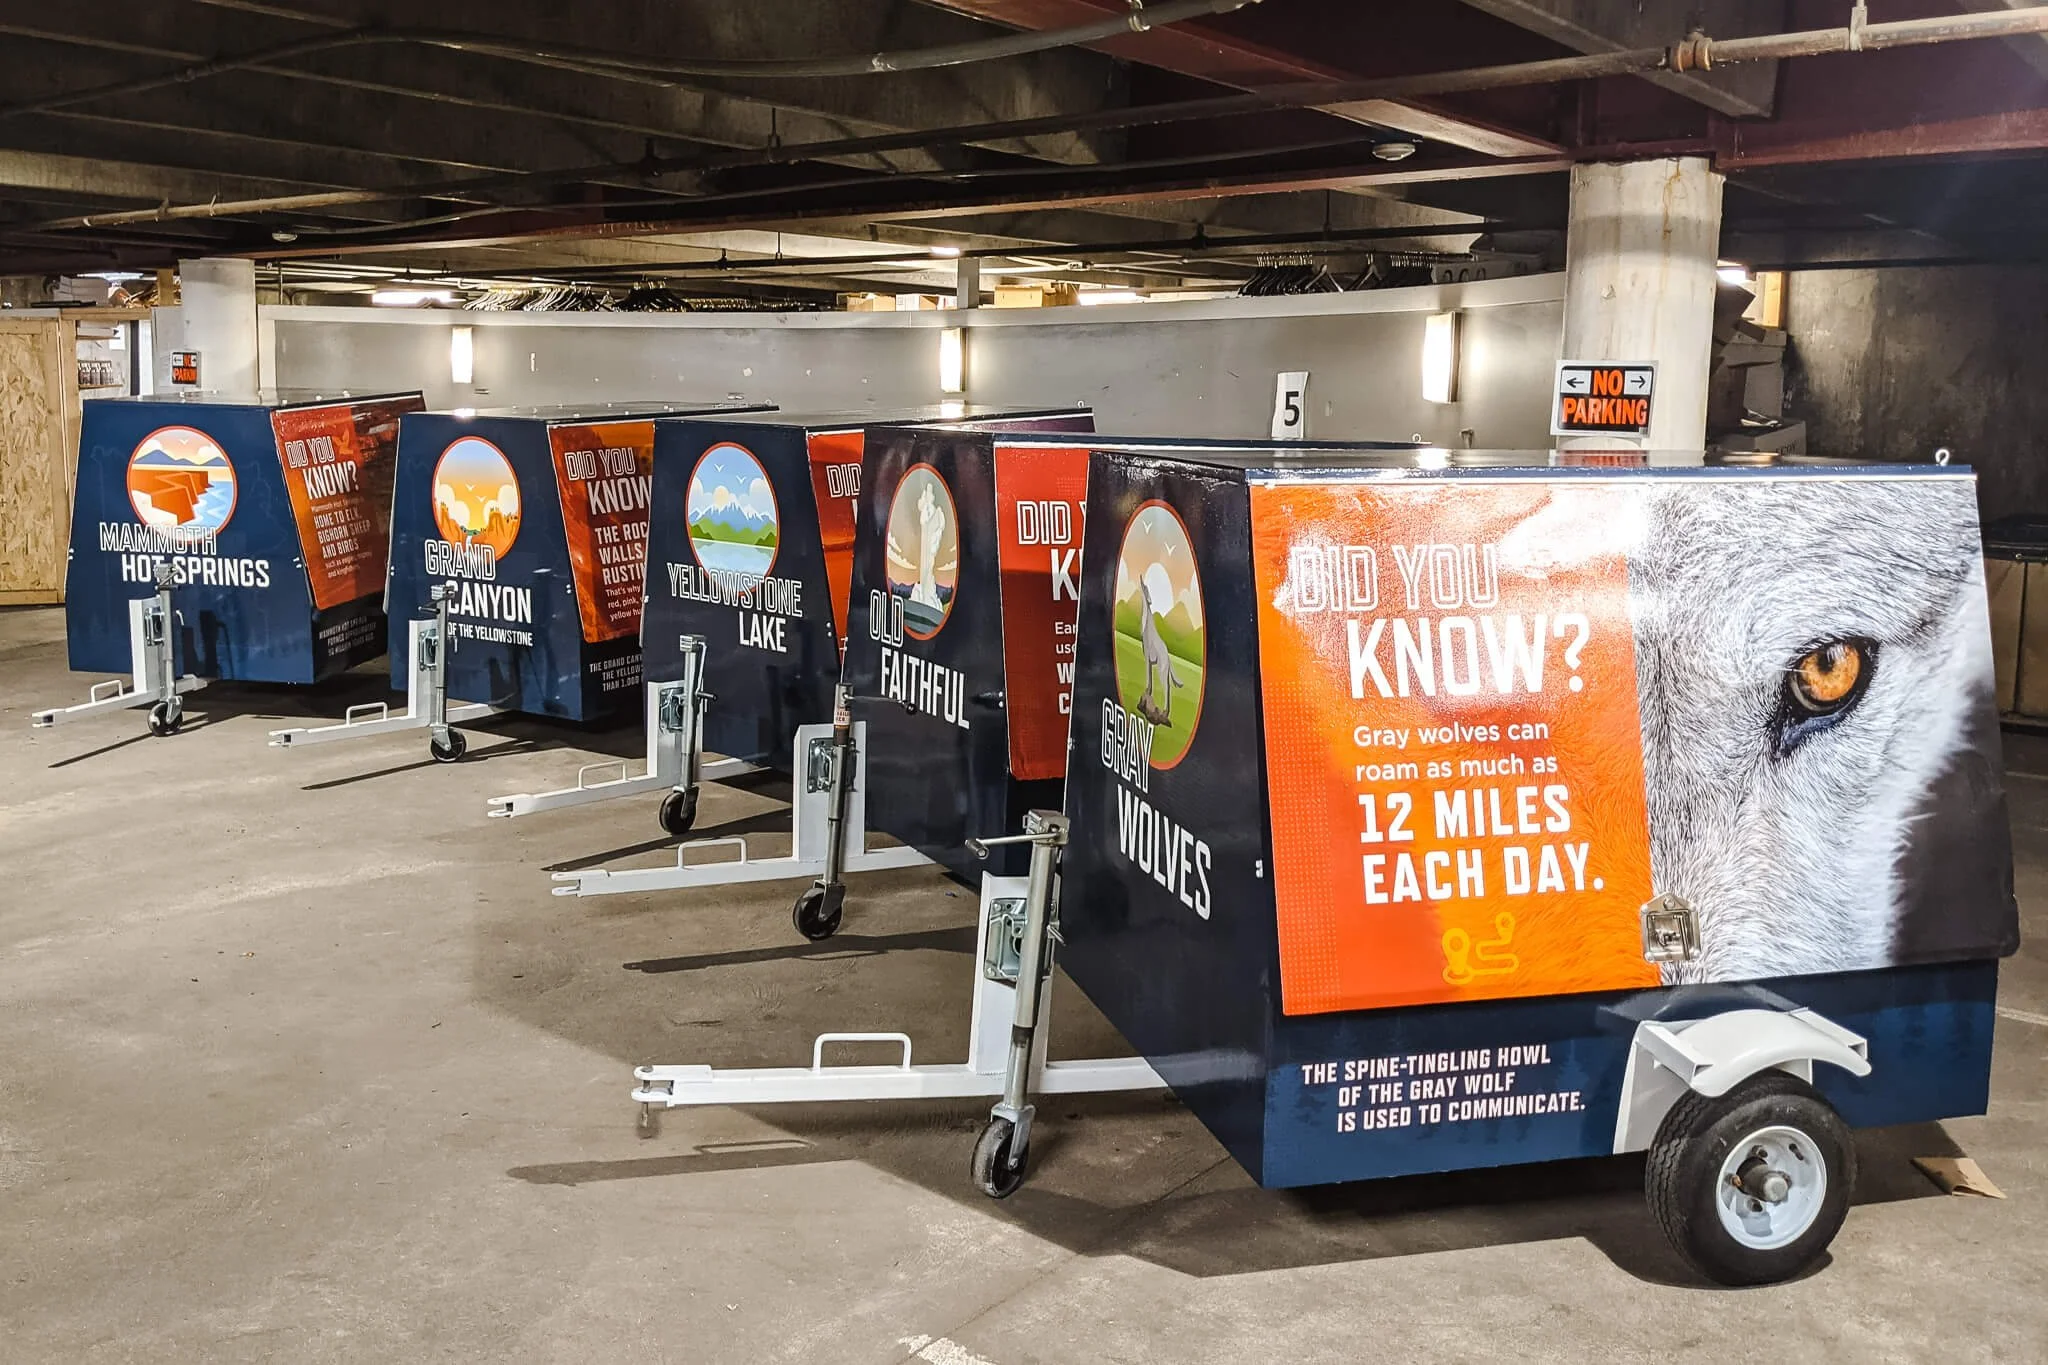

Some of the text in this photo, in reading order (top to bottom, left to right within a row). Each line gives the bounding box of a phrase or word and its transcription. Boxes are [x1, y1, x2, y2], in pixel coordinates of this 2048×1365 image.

[1593, 369, 1623, 396] NO
[1284, 391, 1300, 426] 5
[1562, 398, 1648, 425] PARKING
[285, 436, 335, 468] DID YOU
[564, 447, 636, 480] DID YOU
[302, 461, 360, 500] KNOW?
[826, 463, 862, 498] DID
[314, 512, 334, 529] HOME
[334, 510, 345, 524] TO
[317, 520, 371, 544] BIGHORN SHEEP
[594, 526, 620, 544] THE
[1016, 500, 1072, 545] DID
[99, 522, 217, 556] MAMMOTH
[322, 543, 336, 560] AND
[337, 538, 359, 554] BIRDS
[598, 542, 644, 565] WALLS
[172, 556, 270, 588] SPRINGS
[424, 539, 496, 580] GRAND
[605, 585, 640, 597] That's why
[666, 562, 803, 617] YELLOWSTONE
[1290, 543, 1499, 613] DID YOU
[445, 580, 532, 624] CANYON
[608, 600, 622, 609] red,
[610, 609, 632, 622] yellow
[870, 588, 904, 648] OLD
[447, 622, 533, 647] OF THE YELLOWSTONE
[738, 611, 787, 653] LAKE
[589, 662, 602, 672] THE
[604, 656, 625, 670] GRAND
[602, 664, 644, 681] THE YELLOW
[1347, 613, 1590, 699] KNOW?
[602, 680, 620, 692] THAN
[880, 646, 970, 730] FAITHFUL
[1102, 698, 1154, 794] GRAY
[1353, 722, 1549, 748] Gray wolves can
[1356, 753, 1558, 781] roam as much as
[1358, 784, 1571, 844] 12 MILES
[1118, 784, 1211, 920] WOLVES
[1362, 842, 1604, 904] EACH DAY.
[1302, 1044, 1551, 1085] THE SPINE-TINGLING HOWL
[1338, 1072, 1516, 1108] OF THE GRAY WOLF
[1337, 1091, 1586, 1133] IS USED TO COMMUNICATE.
